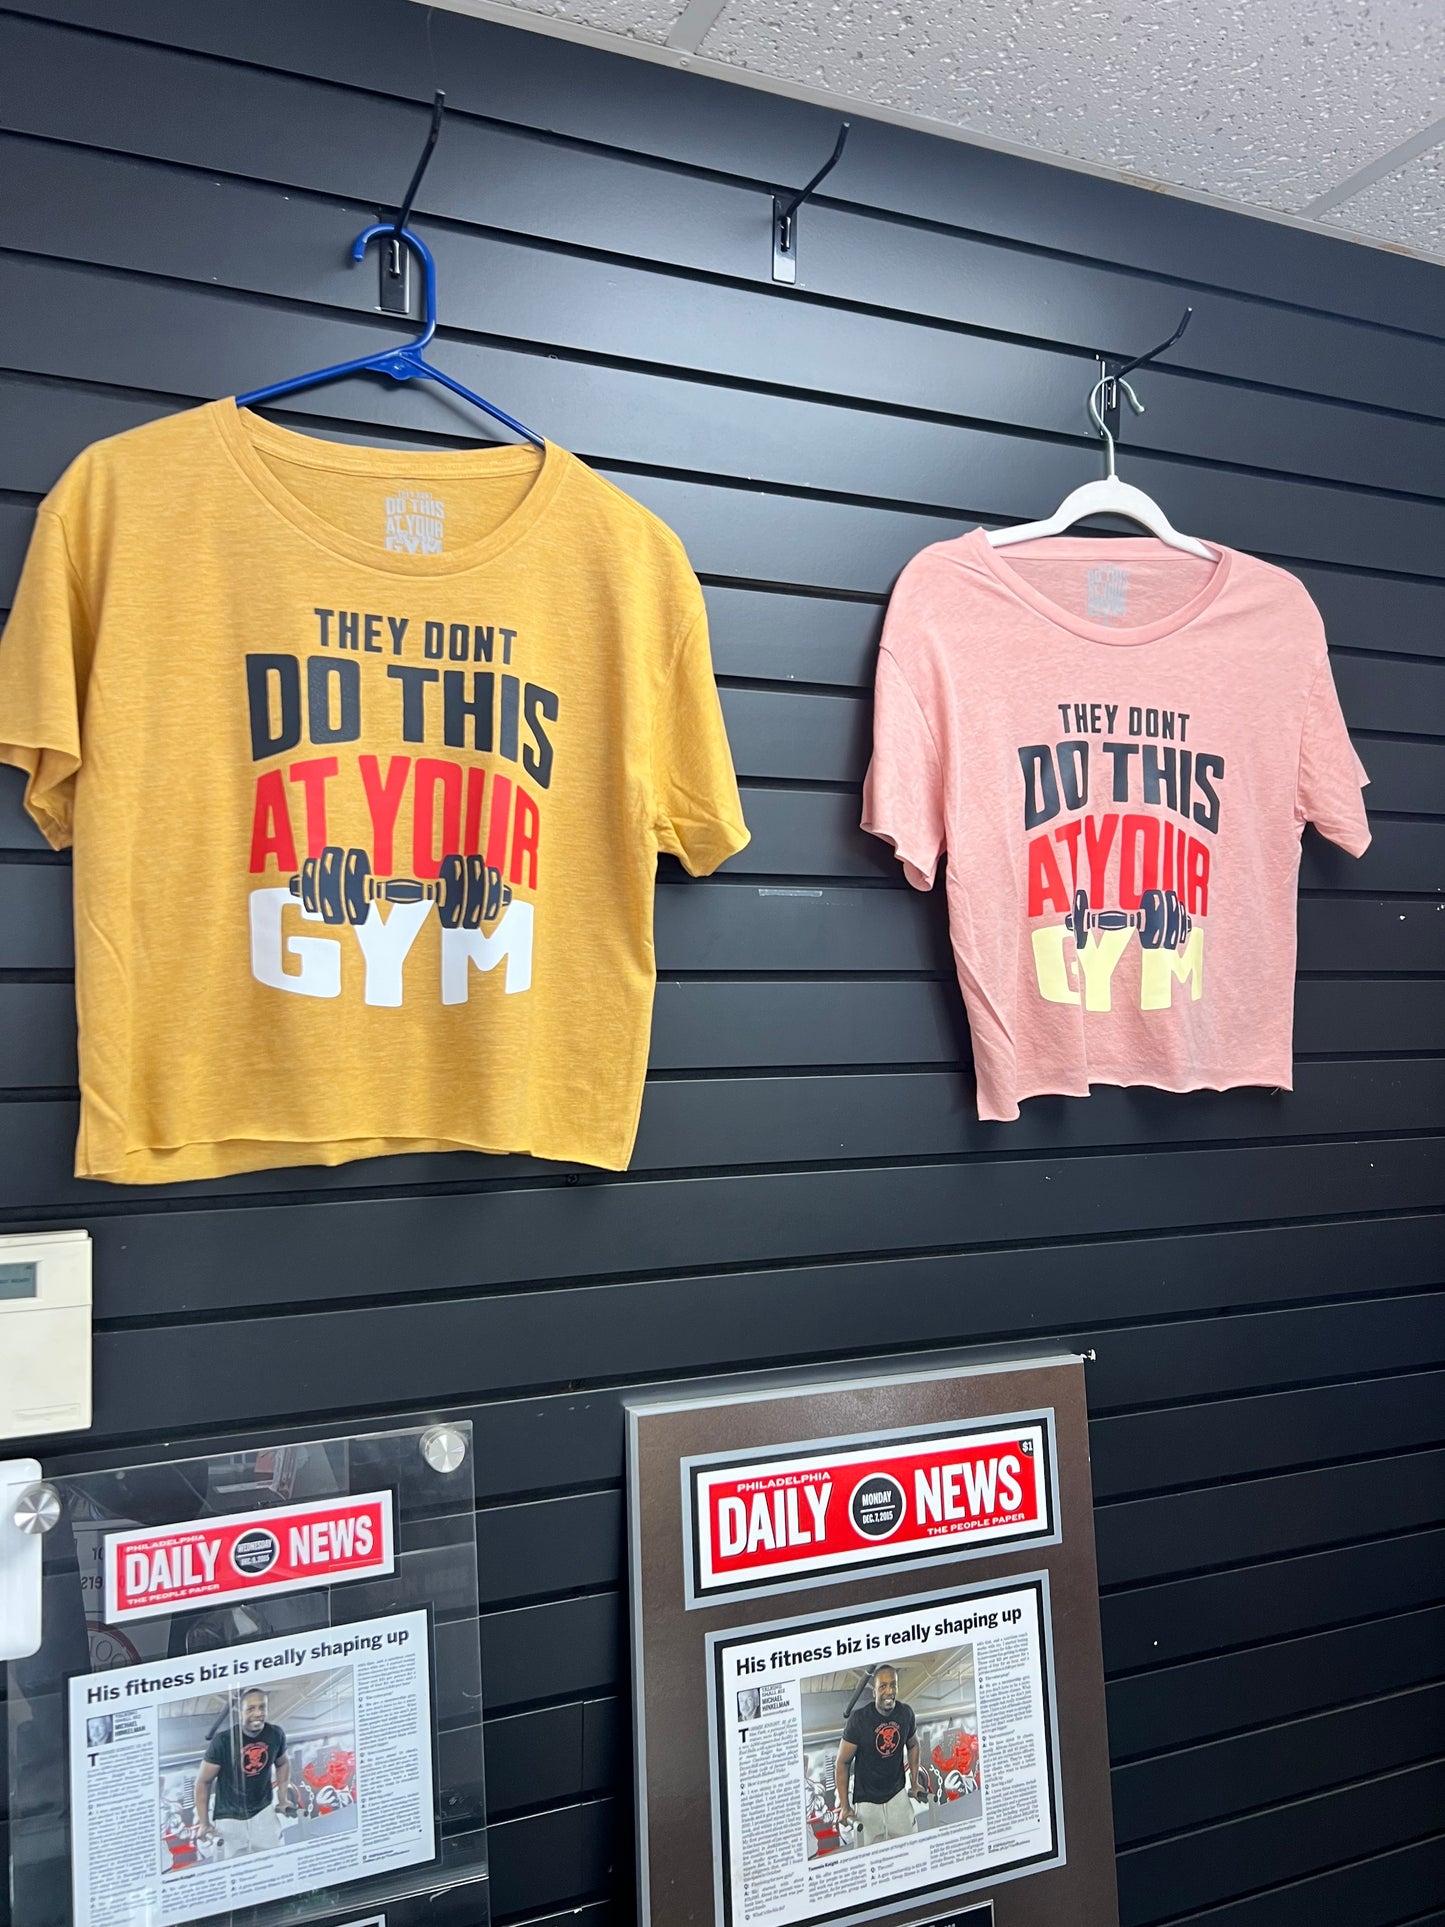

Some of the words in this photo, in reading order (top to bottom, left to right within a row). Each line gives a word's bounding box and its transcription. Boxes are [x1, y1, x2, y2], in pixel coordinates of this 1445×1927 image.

[314, 608, 409, 655] THEY
[424, 621, 517, 665] DONT
[246, 653, 361, 762] DO
[386, 664, 559, 790] THIS
[1058, 703, 1118, 734] THEY
[1128, 707, 1190, 742] DONT
[249, 756, 338, 873] AT
[358, 755, 540, 890] YOUR
[1018, 740, 1089, 831] DO
[1103, 741, 1225, 835] THIS
[249, 887, 534, 1007] GYM
[1031, 927, 1204, 1012] GYM
[718, 1482, 833, 1557] DAILY
[914, 1454, 1022, 1525] NEWS
[737, 1472, 831, 1493] PHILADELPHIA
[862, 1490, 892, 1506] MONDAY
[126, 1534, 205, 1552] PHILADELPHIA
[126, 1539, 222, 1596] DAILY
[289, 1515, 374, 1567] NEWS
[927, 1526, 948, 1535] THE
[950, 1518, 990, 1532] PEOPLE
[992, 1513, 1025, 1525] PAPER
[149, 1589, 188, 1601] PEOPLE
[189, 1583, 220, 1595] PAPER
[87, 1685, 120, 1704] His
[125, 1671, 195, 1696] fitness
[200, 1663, 229, 1682] biz
[233, 1660, 249, 1675] is
[254, 1647, 306, 1670] really
[311, 1634, 383, 1659] shaping
[387, 1629, 409, 1645] up
[736, 1656, 766, 1676] His
[770, 1645, 832, 1669] fitness
[836, 1637, 862, 1656] biz
[866, 1634, 880, 1650] is
[885, 1624, 931, 1647] really
[934, 1612, 998, 1636] shaping
[1002, 1607, 1022, 1624] up
